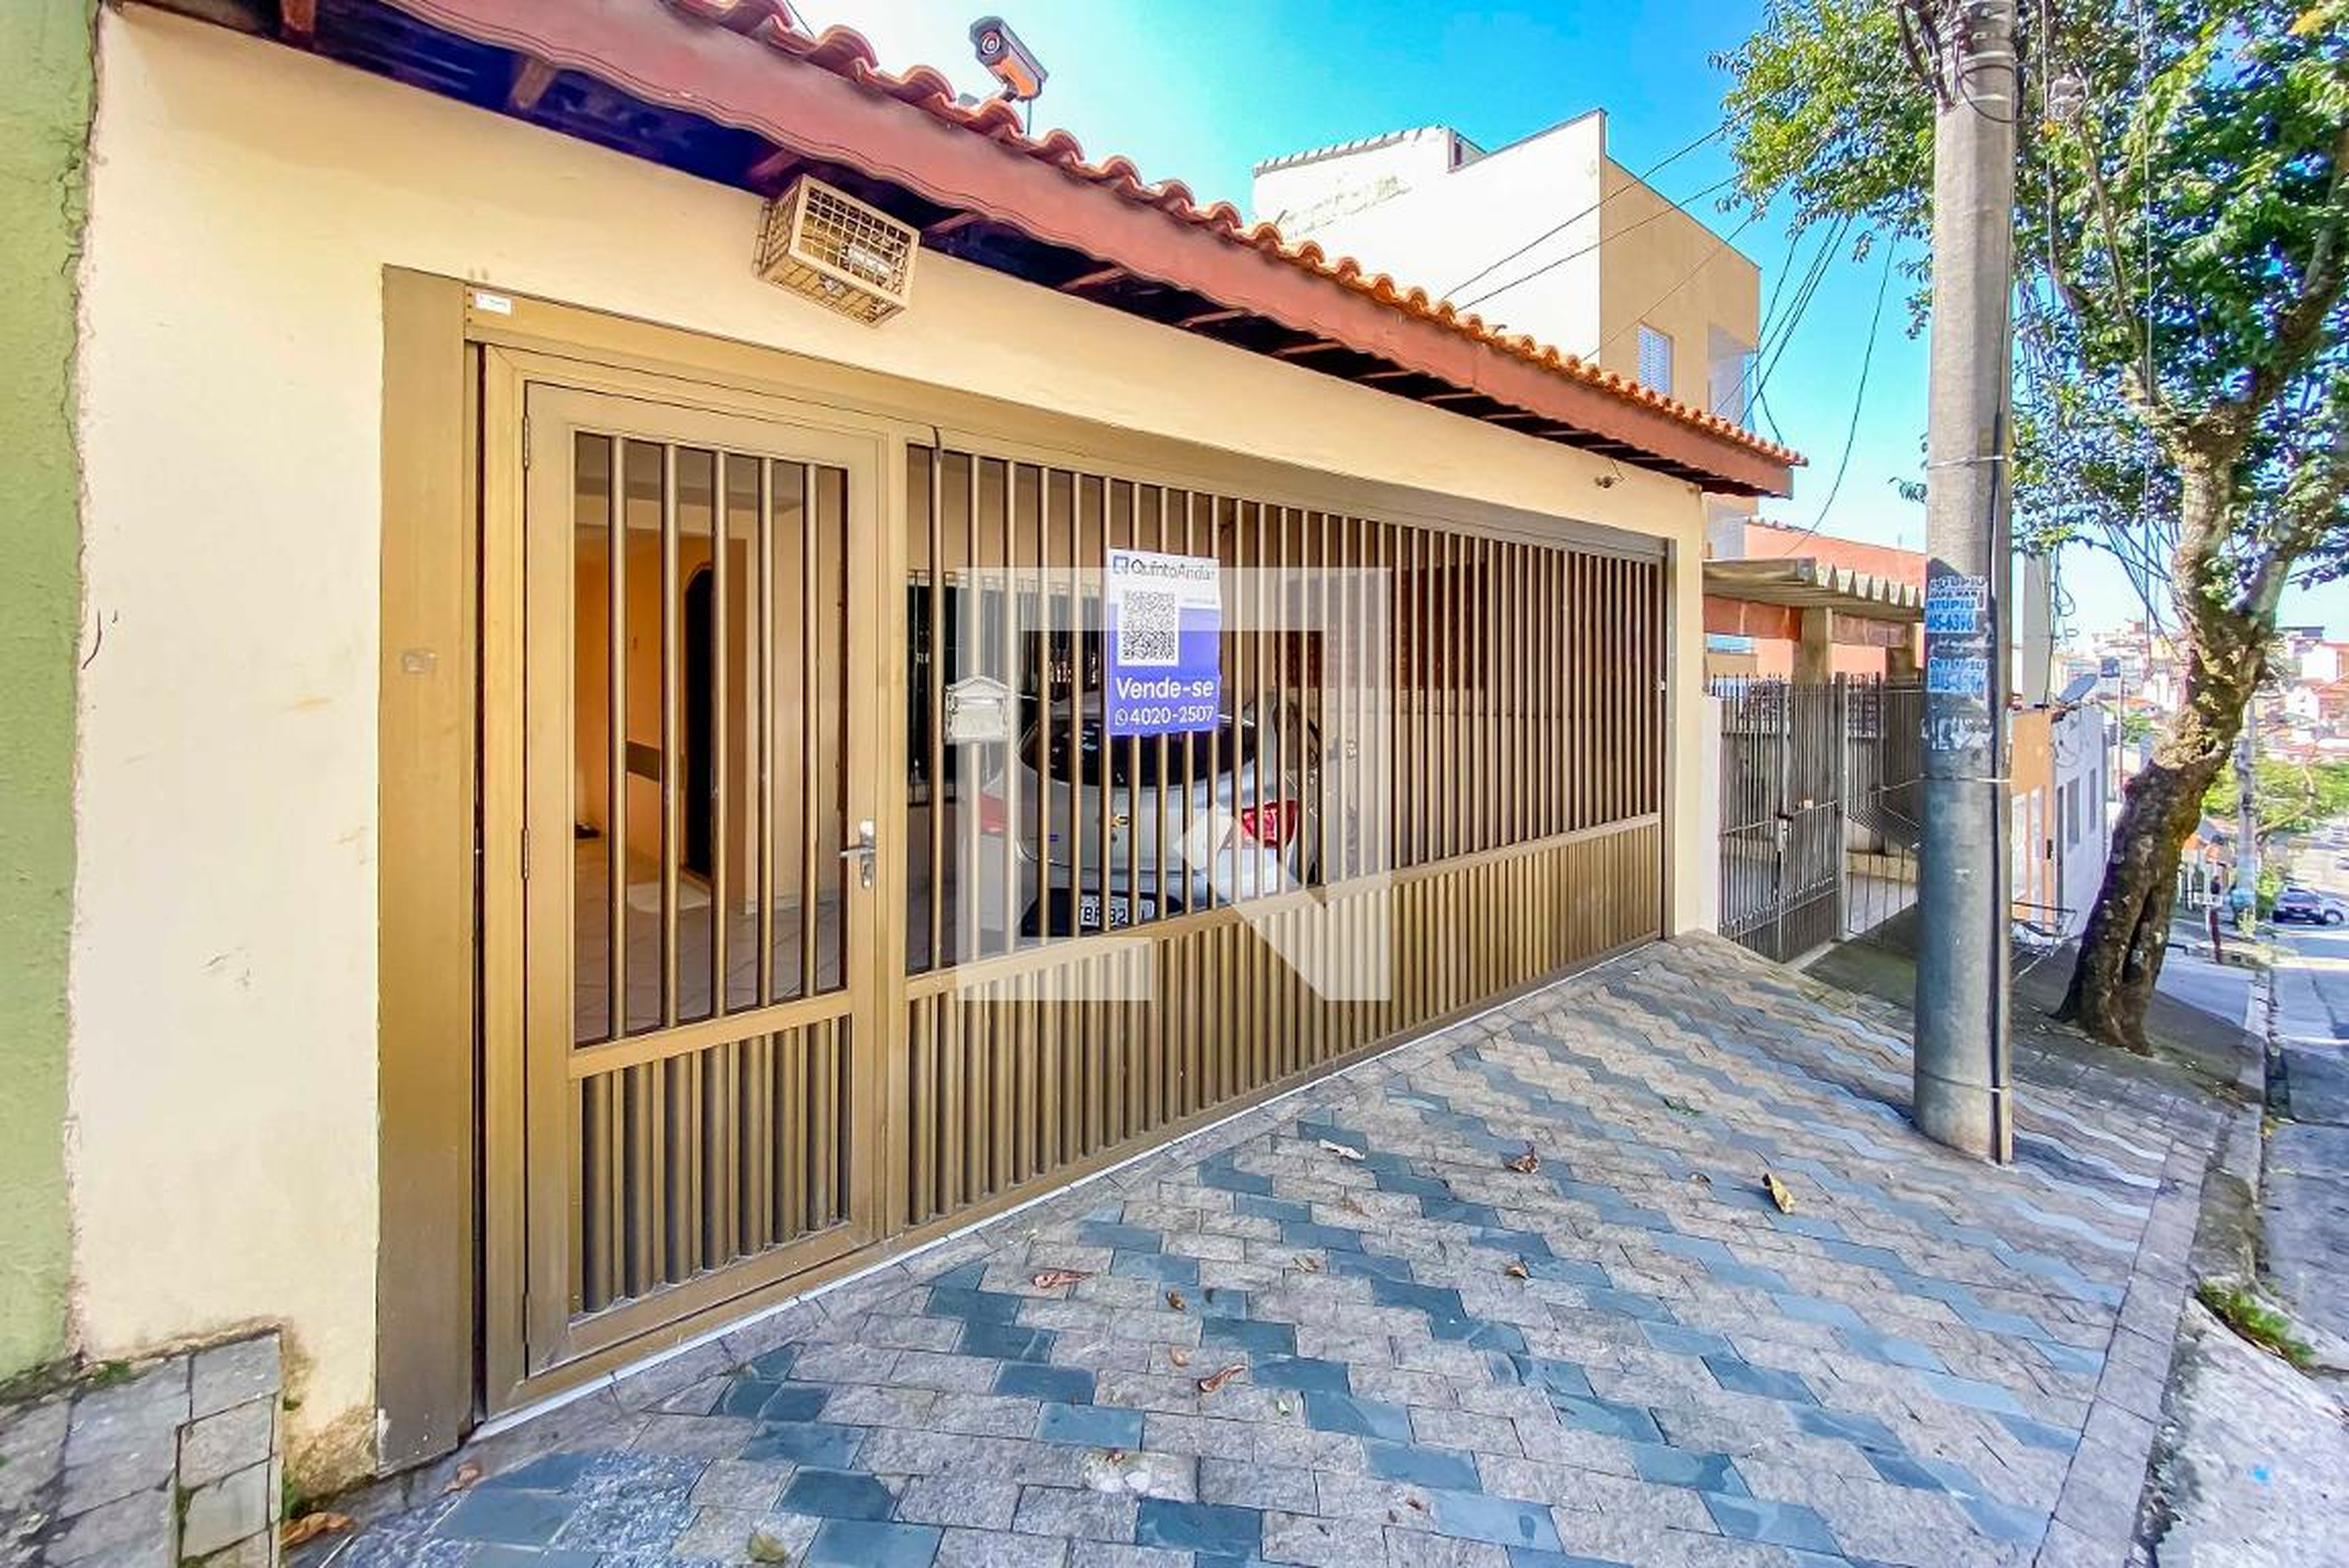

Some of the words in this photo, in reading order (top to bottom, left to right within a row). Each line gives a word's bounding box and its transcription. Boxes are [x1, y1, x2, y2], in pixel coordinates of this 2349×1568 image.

[1131, 558, 1215, 580] QuintoAndar
[1116, 676, 1214, 700] Vende-se
[1130, 706, 1214, 725] 4020-2507
